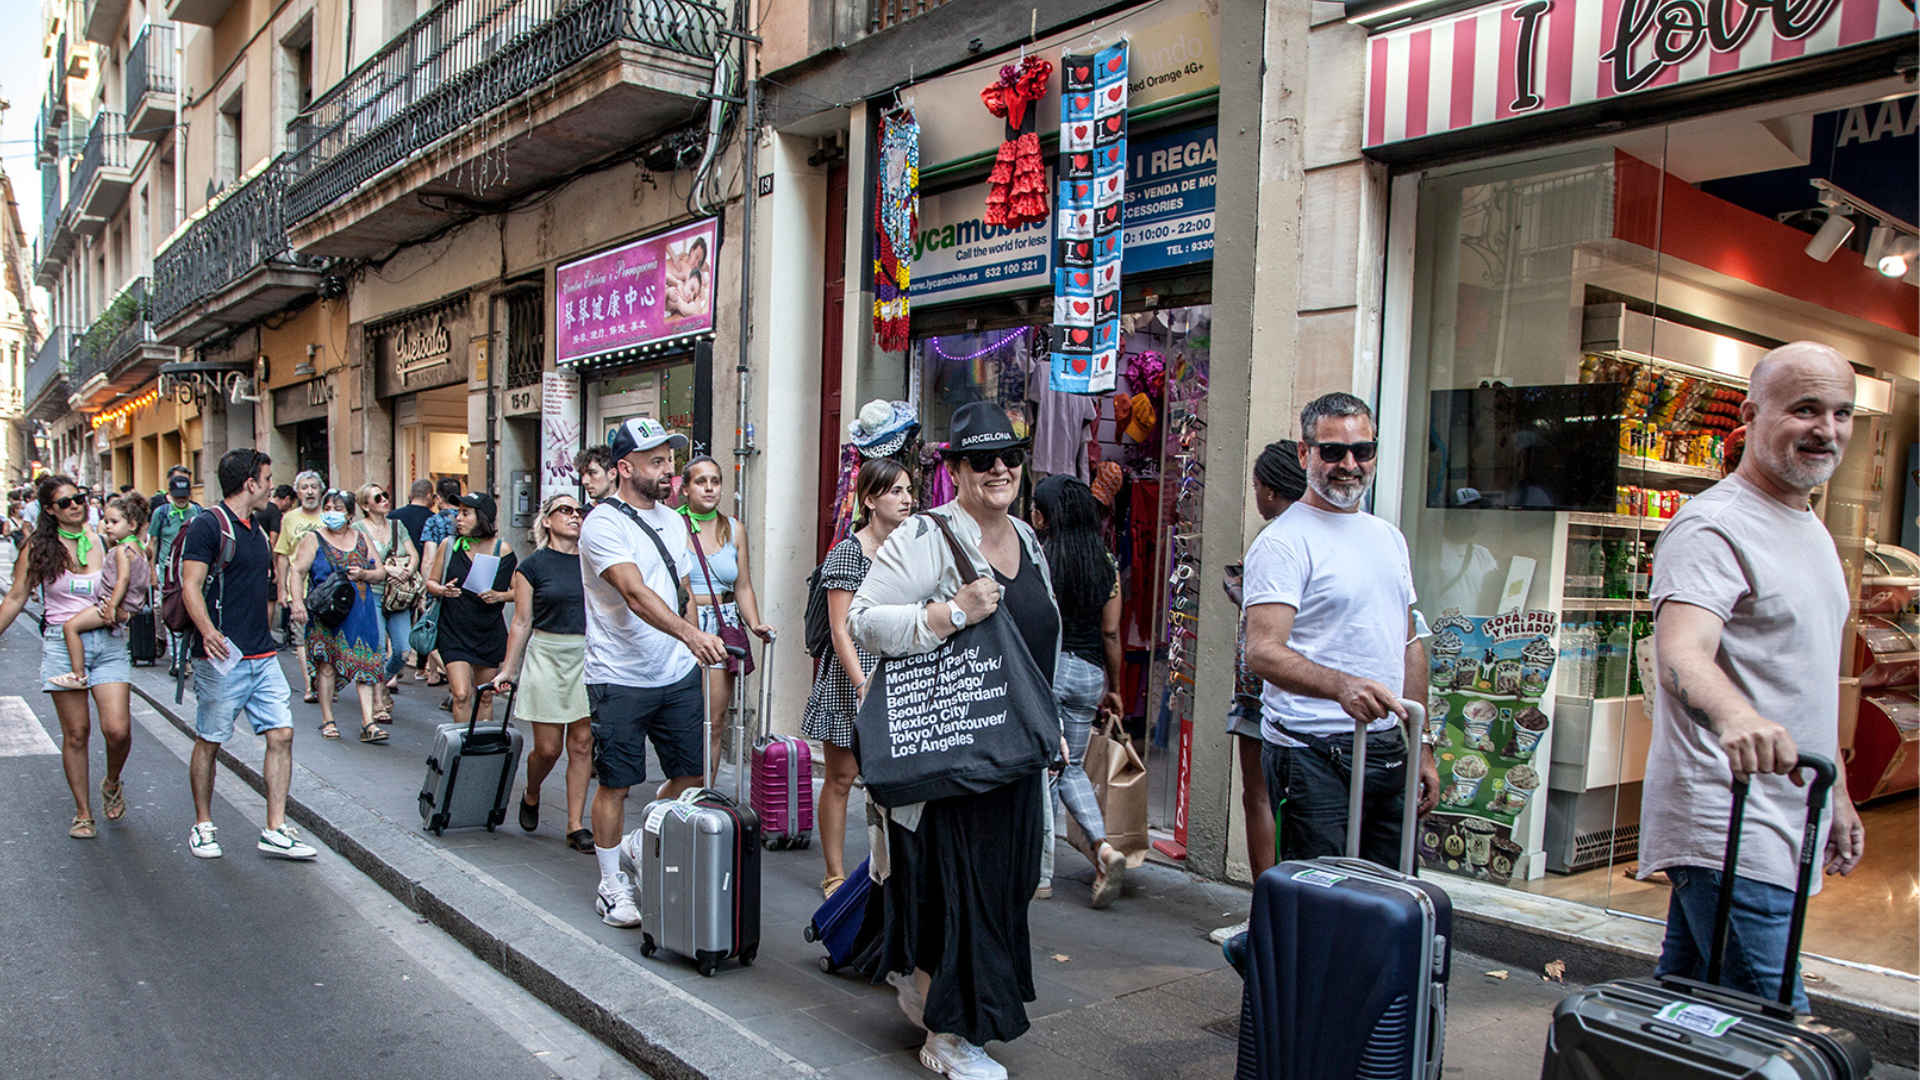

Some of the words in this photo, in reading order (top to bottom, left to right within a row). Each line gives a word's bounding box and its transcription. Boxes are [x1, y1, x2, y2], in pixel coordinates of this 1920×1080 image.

[1510, 0, 1549, 109] I
[1067, 66, 1074, 84] I
[1098, 62, 1105, 80] I
[1128, 79, 1145, 94] Red
[1147, 70, 1182, 87] Orange
[1184, 62, 1204, 75] 4G+
[1099, 91, 1105, 108] I
[1097, 120, 1105, 138] I
[1097, 150, 1105, 167] I
[1152, 138, 1218, 175] REGA
[761, 177, 770, 194] 19
[1069, 184, 1078, 201] I
[1098, 180, 1105, 197] I
[1144, 183, 1178, 199] VENDA
[1182, 179, 1196, 191] DE
[1199, 174, 1216, 187] MO
[1068, 213, 1076, 229] I
[1097, 210, 1106, 227] I
[1139, 226, 1169, 240] 10:00
[1178, 218, 1210, 234] 22:00
[956, 248, 972, 261] Call
[974, 246, 987, 256] the
[989, 240, 1013, 254] world
[1015, 238, 1027, 250] for
[1028, 235, 1047, 247] less
[1065, 241, 1076, 258] I
[1097, 240, 1104, 256] I
[1191, 240, 1214, 251] 9330
[985, 267, 1001, 278] 632
[1004, 264, 1020, 274] 100
[1022, 260, 1038, 272] 321
[1065, 271, 1072, 286] I
[1097, 270, 1104, 286] I
[564, 285, 656, 330] 琴琴健康中心
[1097, 299, 1103, 316] I
[1063, 328, 1070, 345] I
[1096, 329, 1102, 344] I
[1061, 358, 1070, 374] I
[1094, 358, 1100, 373] I
[961, 432, 1011, 447] BARCELONA
[1492, 628, 1500, 637] Y
[1504, 622, 1556, 636] HELADO!
[969, 655, 1003, 673] York/
[889, 713, 937, 733] Mexico
[940, 703, 970, 722] City/
[890, 710, 1007, 745] Tokyo/Vancouver/
[891, 744, 917, 758] Los
[920, 733, 974, 752] Angeles
[1450, 839, 1459, 849] M
[1475, 840, 1483, 849] M
